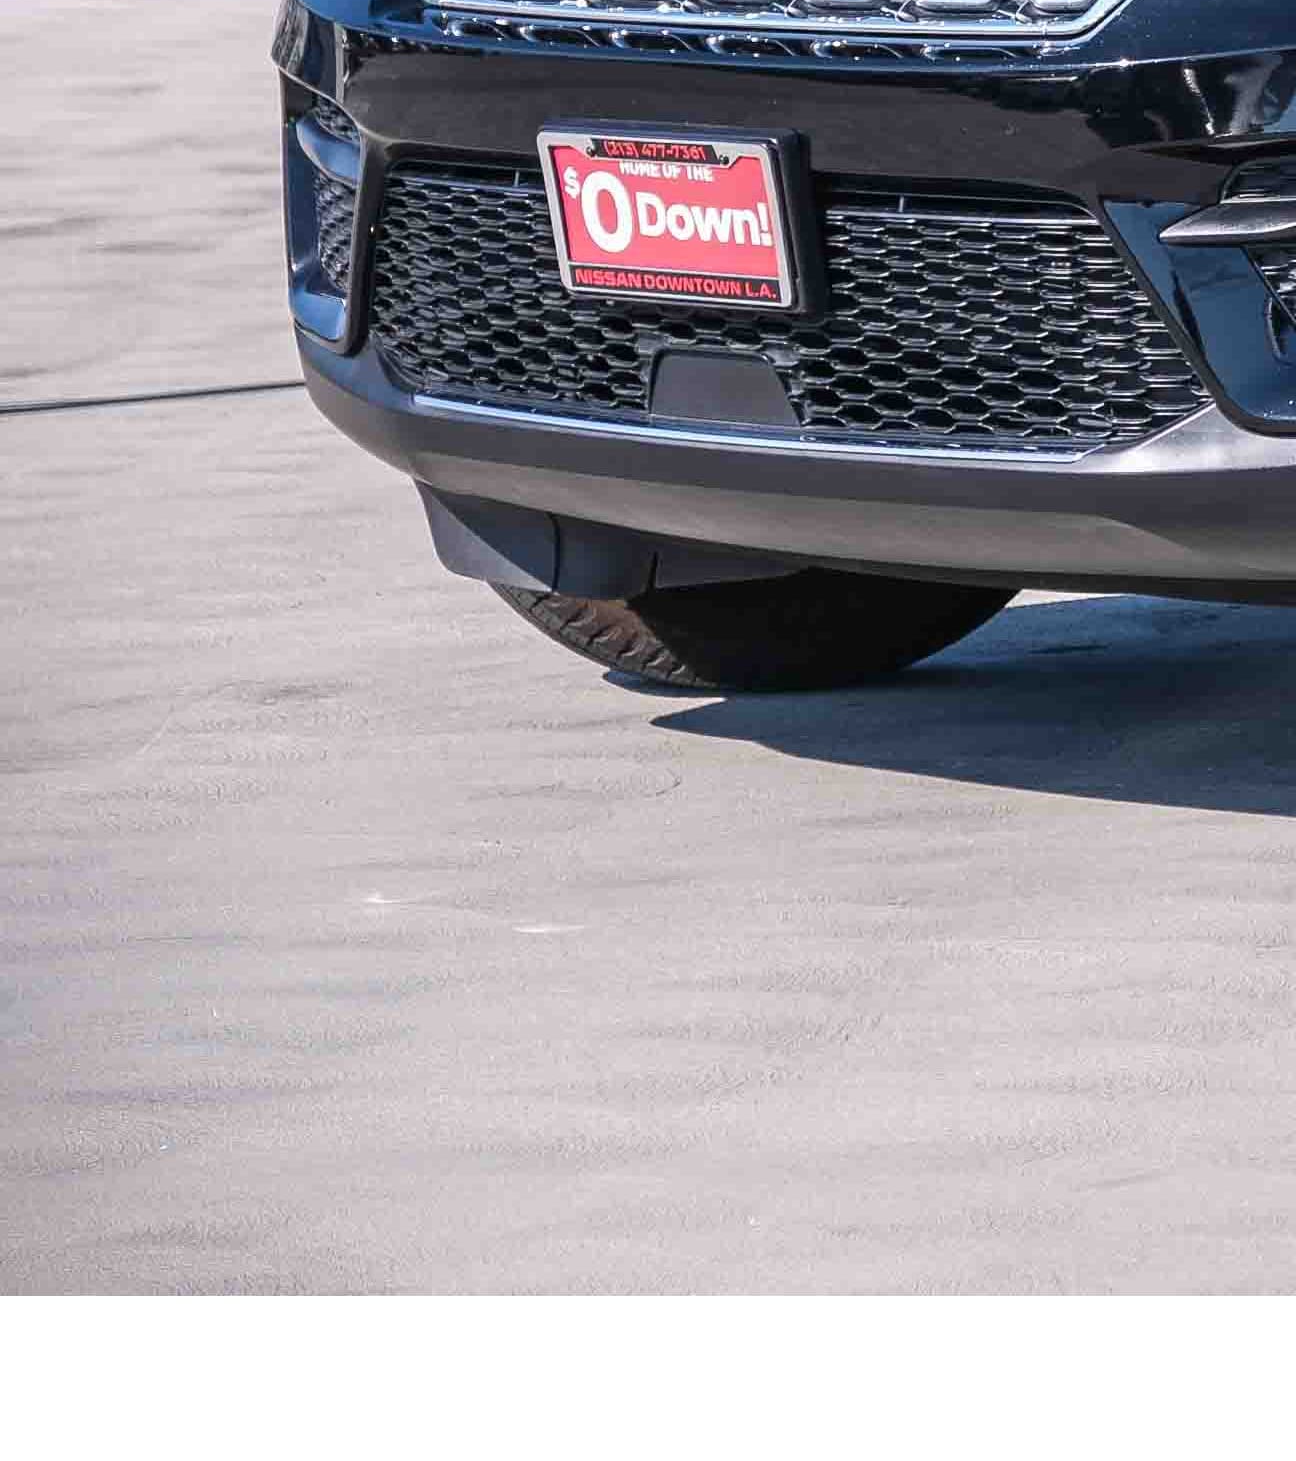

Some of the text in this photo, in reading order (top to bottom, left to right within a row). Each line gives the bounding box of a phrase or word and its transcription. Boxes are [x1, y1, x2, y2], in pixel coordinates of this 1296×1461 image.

[619, 161, 714, 183] HOME OF THE
[635, 191, 774, 247] Down!
[575, 268, 778, 300] NISSAN DOWNTOWN L.A.
